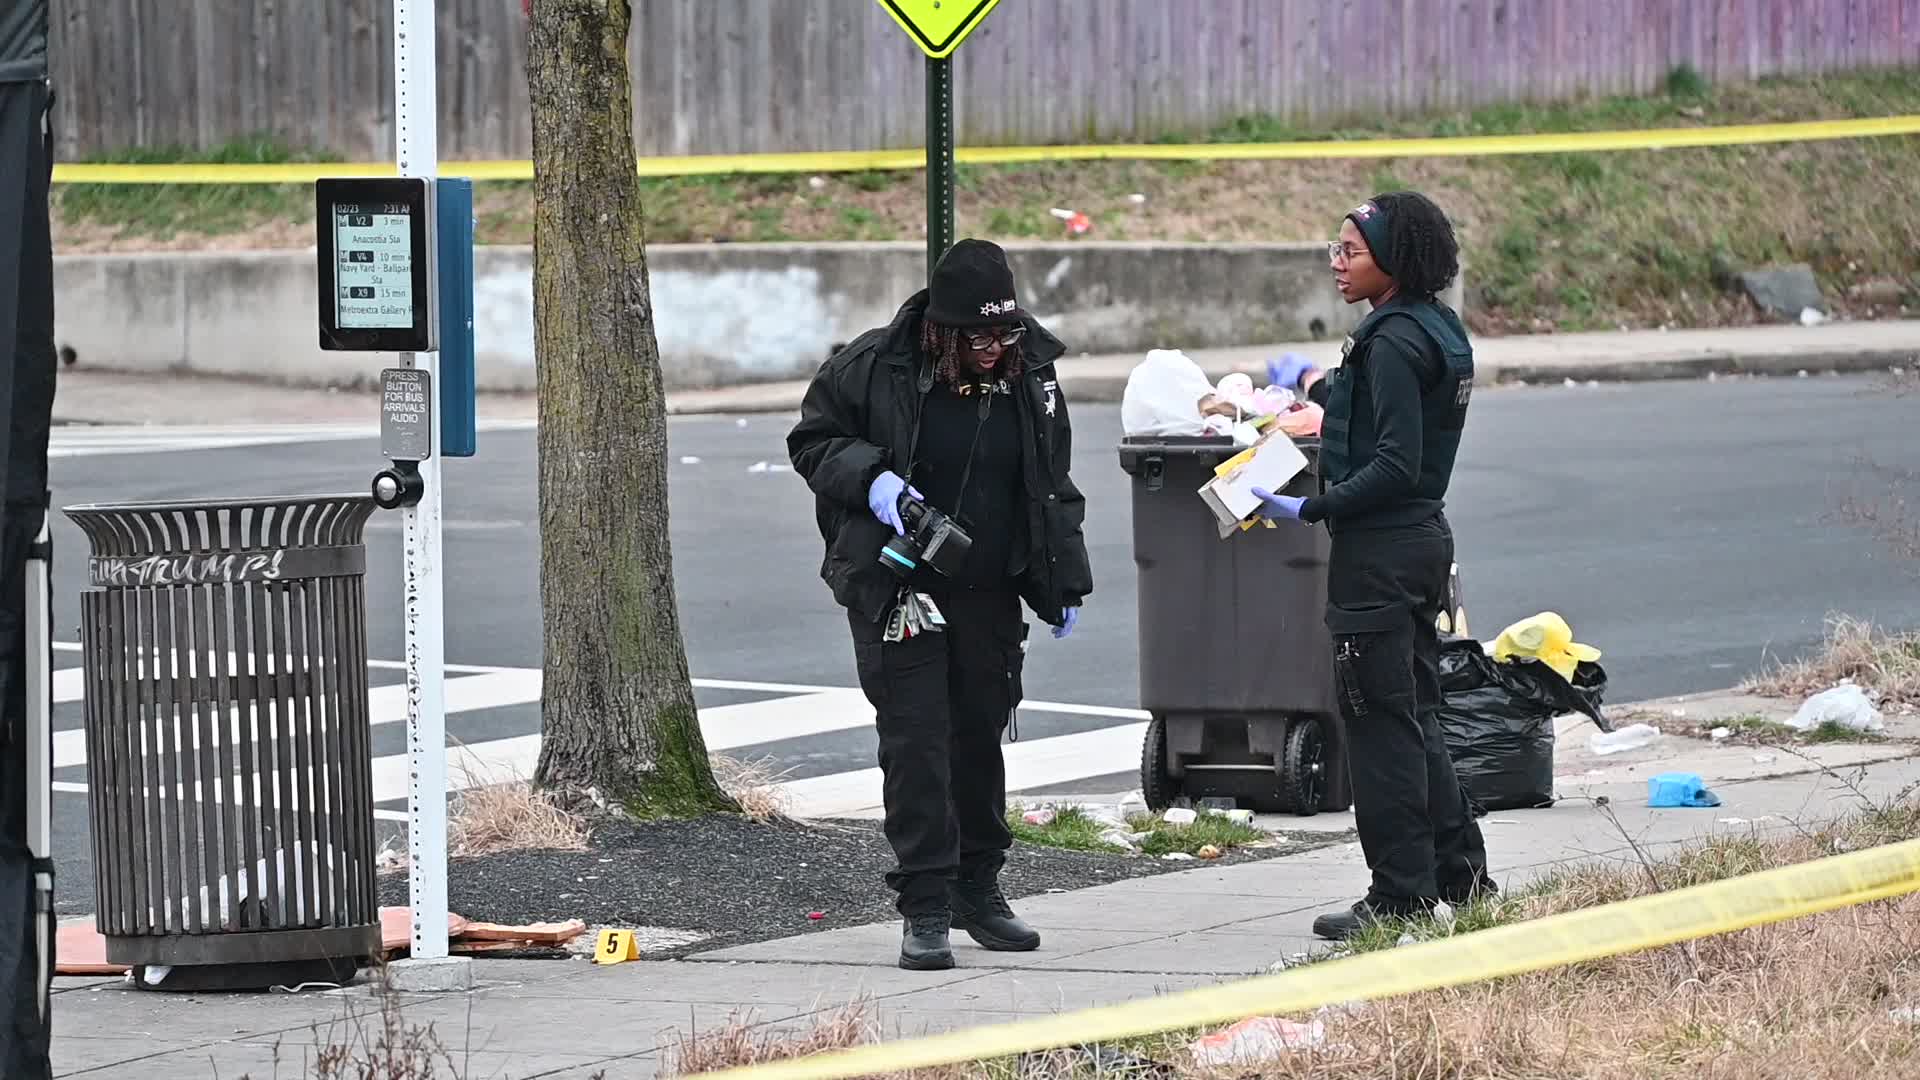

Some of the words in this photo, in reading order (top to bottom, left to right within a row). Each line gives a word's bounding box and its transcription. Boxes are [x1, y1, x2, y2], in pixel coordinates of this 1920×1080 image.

[337, 204, 359, 213] 02/23
[384, 203, 399, 213] 7:31
[355, 216, 367, 225] V2
[384, 217, 389, 225] 3
[352, 235, 387, 244] Anacostia
[389, 235, 401, 244] Sta
[356, 252, 367, 261] V4
[380, 253, 389, 262] 10
[391, 254, 405, 262] min
[340, 264, 357, 274] Navy
[360, 264, 375, 273] Yard
[371, 275, 382, 284] Sta
[357, 288, 369, 298] X9
[381, 288, 391, 297] 15
[340, 305, 378, 314] Metroextra
[381, 305, 406, 316] Gallery
[389, 371, 419, 380] PRESS
[386, 382, 422, 391] BUTTON
[385, 392, 403, 401] FOR
[405, 392, 423, 402] BUS
[384, 403, 425, 413] ARRIVALS
[391, 413, 418, 423] AUDIO
[606, 933, 618, 954] 5
